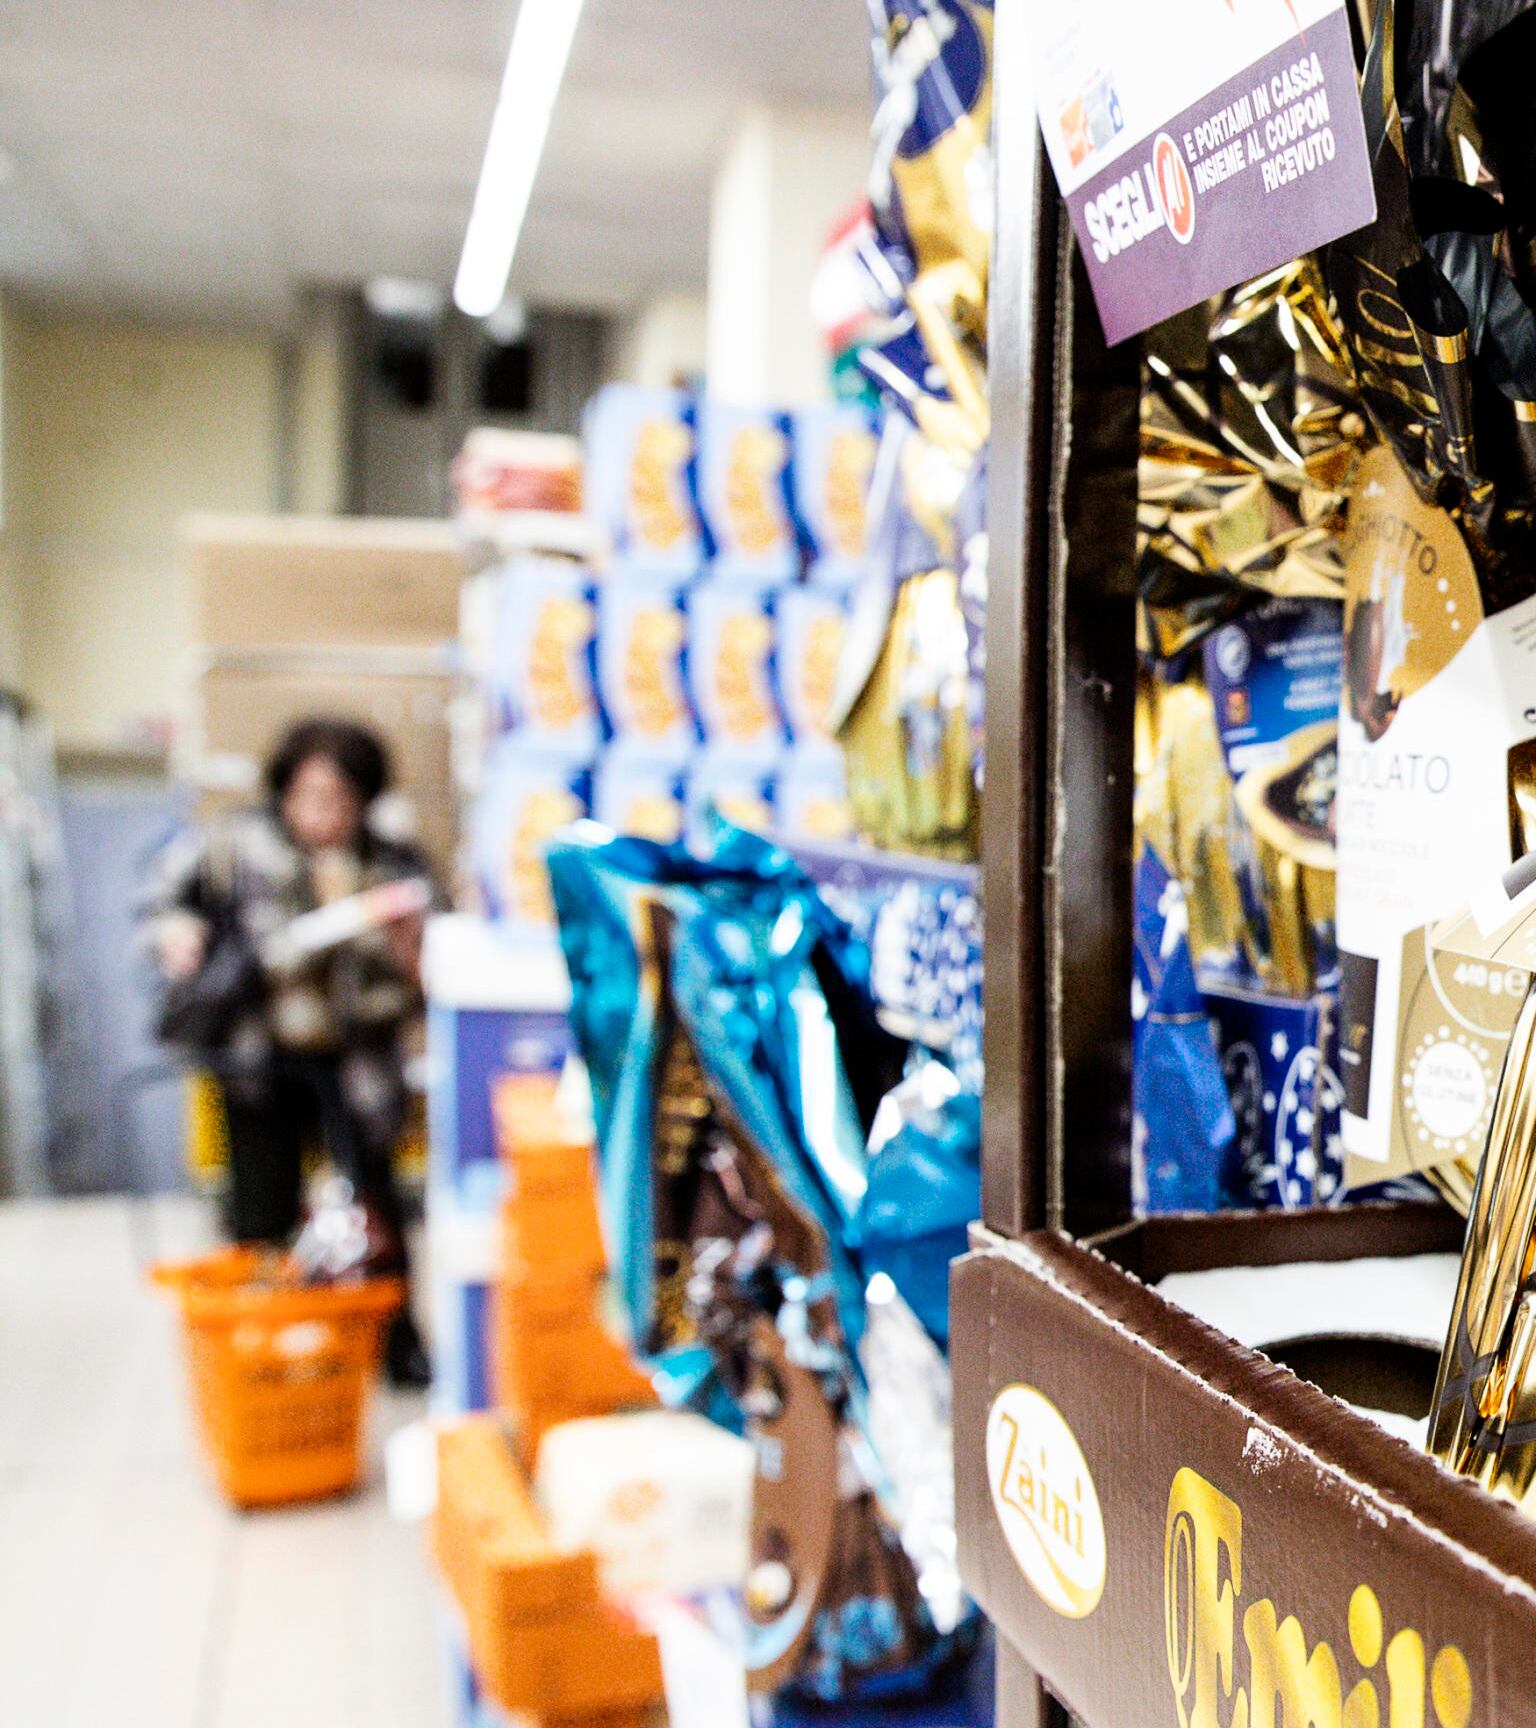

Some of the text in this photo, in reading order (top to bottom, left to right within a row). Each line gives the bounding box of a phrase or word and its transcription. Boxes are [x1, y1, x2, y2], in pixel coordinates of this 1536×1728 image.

[1183, 51, 1325, 163] E PORTAMI IN CASSA
[1193, 138, 1247, 195] INSIEME
[1247, 129, 1266, 165] AL
[1265, 88, 1330, 152] COUPON
[1261, 127, 1336, 194] RICEVUTO
[1000, 1411, 1084, 1559] Zaini
